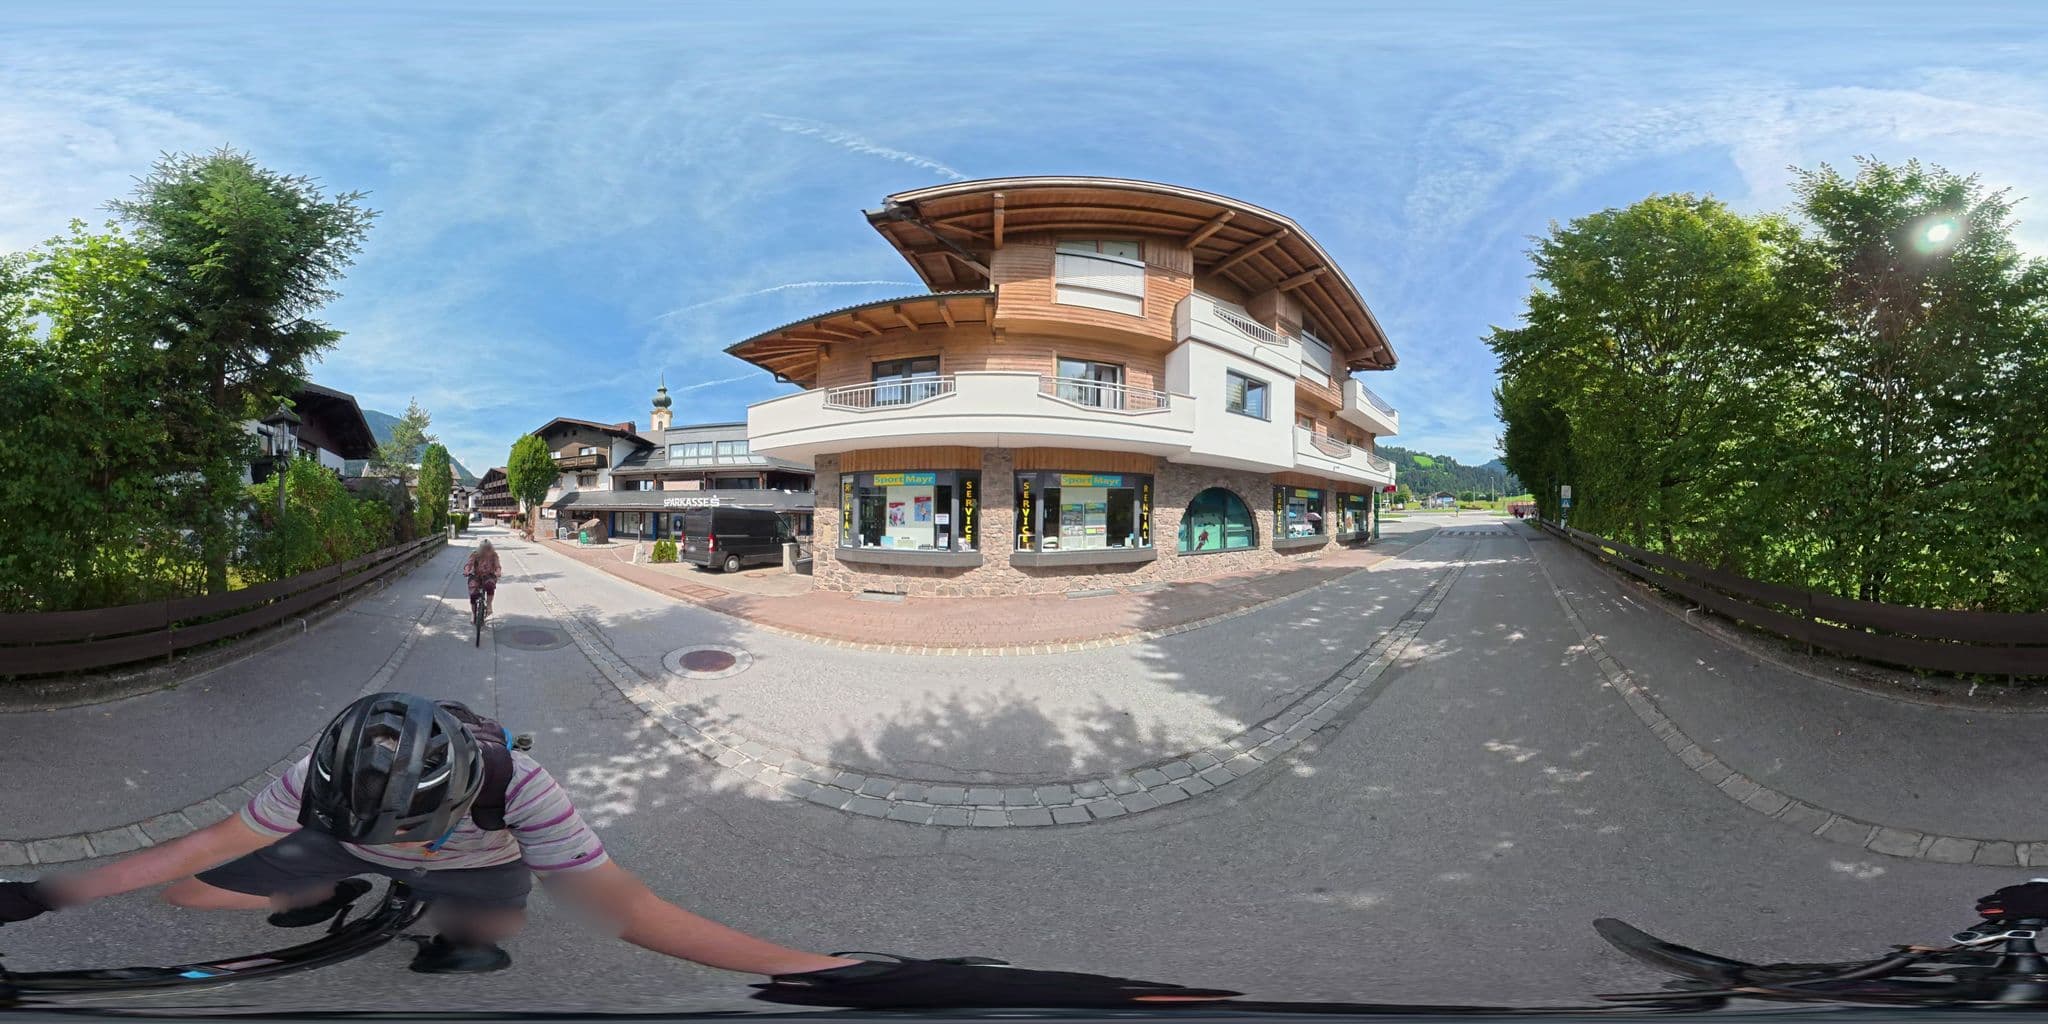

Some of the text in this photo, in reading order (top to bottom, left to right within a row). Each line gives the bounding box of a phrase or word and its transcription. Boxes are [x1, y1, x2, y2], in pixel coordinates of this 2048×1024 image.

[875, 475, 933, 485] Sport Mayr
[1062, 475, 1120, 487] Sport Mayr
[664, 497, 709, 507] SPARKASSE
[1022, 482, 1030, 543] SERVICE
